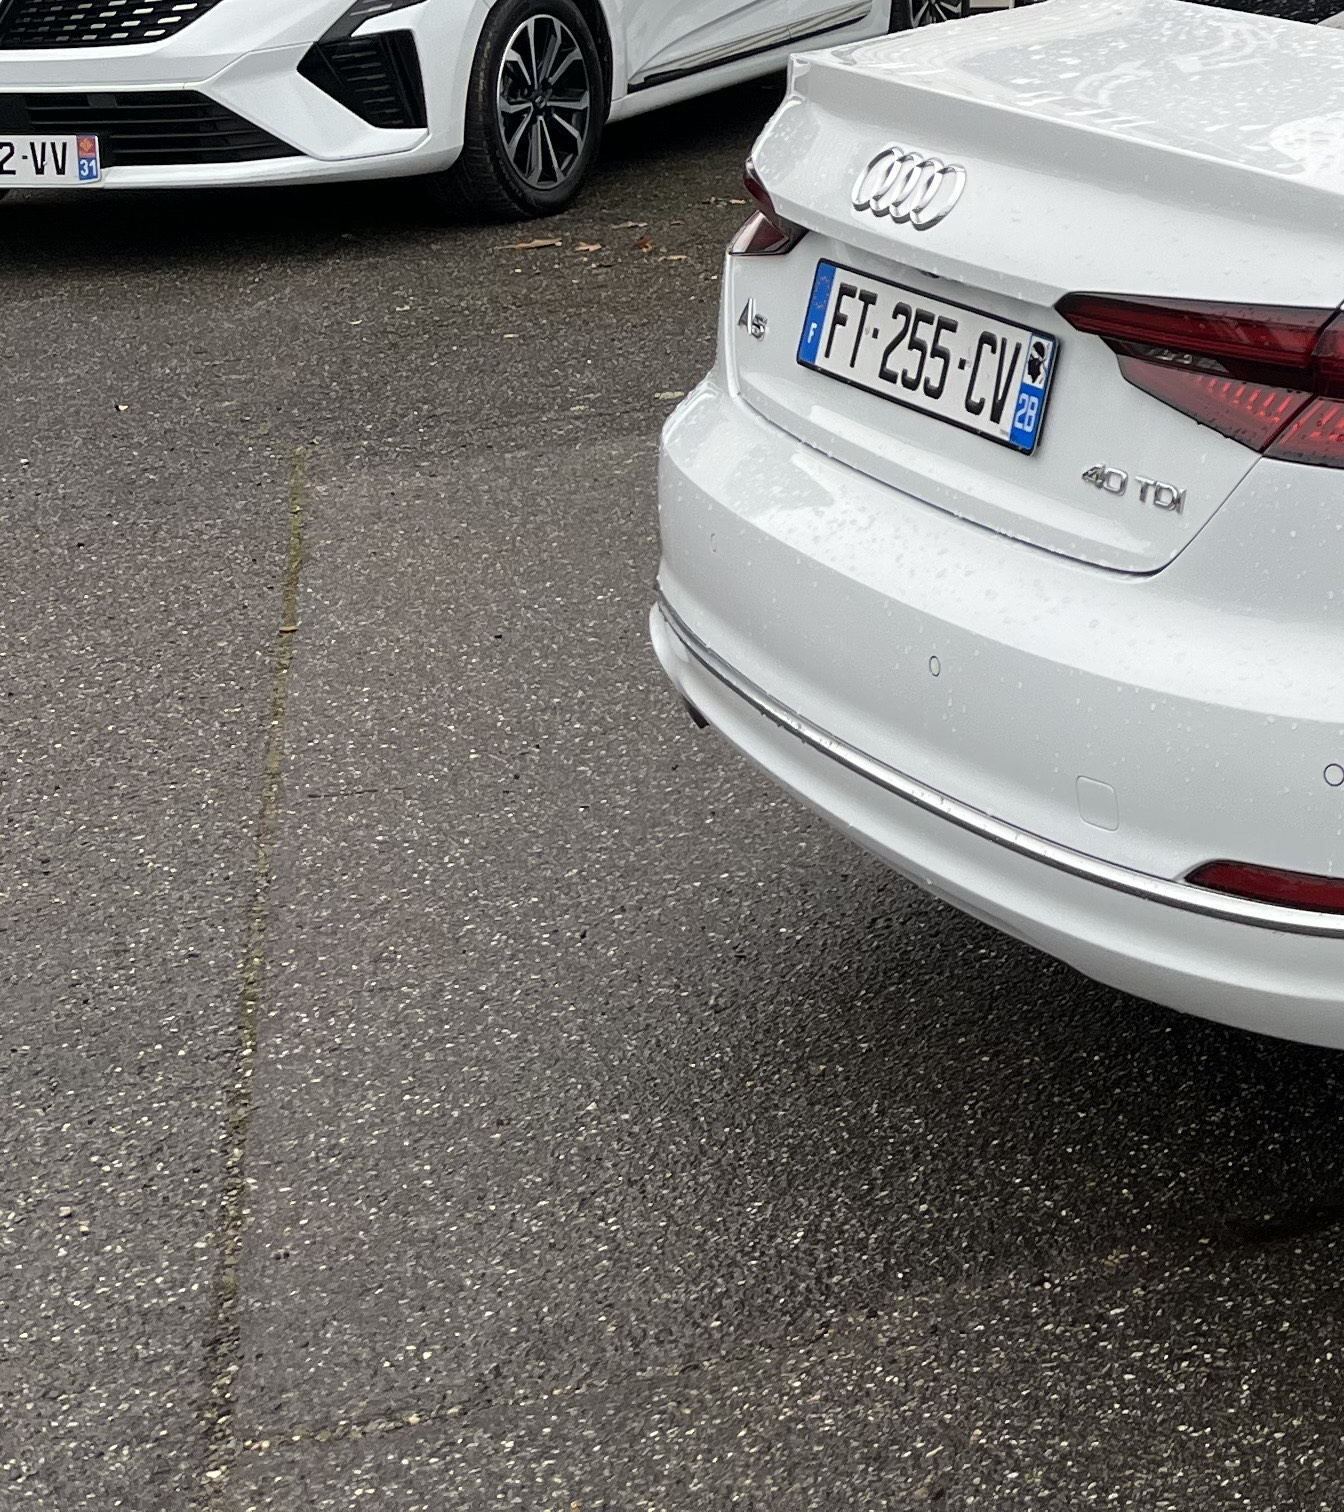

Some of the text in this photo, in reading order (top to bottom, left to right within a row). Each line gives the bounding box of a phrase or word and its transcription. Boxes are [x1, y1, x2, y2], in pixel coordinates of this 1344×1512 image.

[79, 159, 97, 177] 31
[737, 297, 768, 341] A5
[807, 321, 818, 344] F
[824, 282, 1022, 424] FT-255-CV
[1014, 392, 1039, 433] 2B
[1081, 462, 1187, 515] 40 TDI
